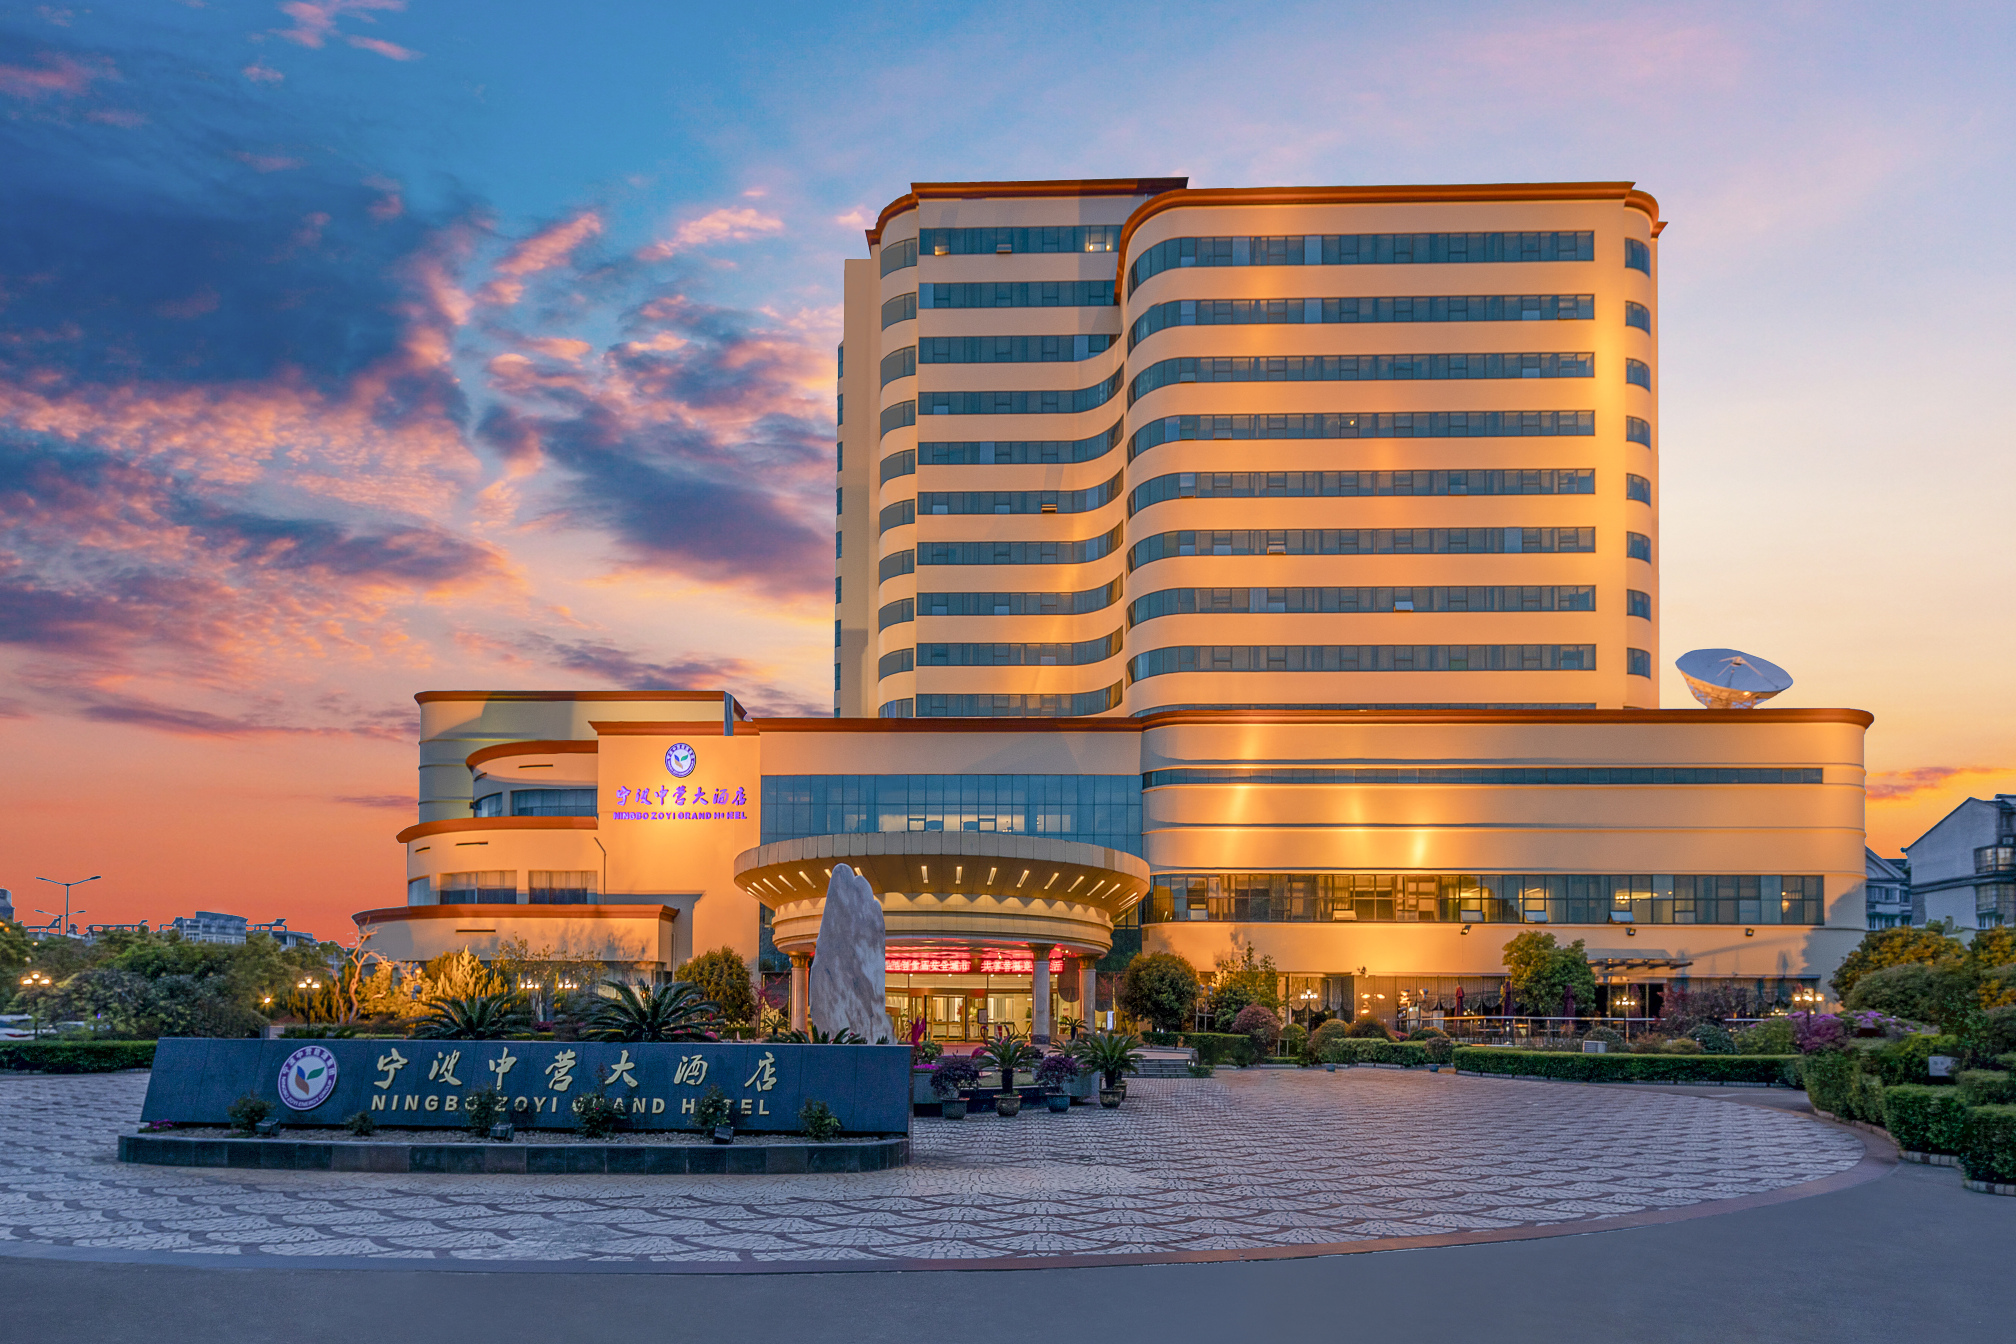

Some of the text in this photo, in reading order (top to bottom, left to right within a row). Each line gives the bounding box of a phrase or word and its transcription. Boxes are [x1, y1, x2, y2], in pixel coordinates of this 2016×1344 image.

[616, 785, 747, 806] 宁波中营大酒店
[613, 811, 649, 820] NINGBO
[650, 811, 676, 820] ZOYI
[677, 811, 711, 820] GRAND
[373, 1047, 777, 1092] 宁波中营大酒店
[371, 1095, 770, 1115] NINGBO ZOYI GAND HTEL
